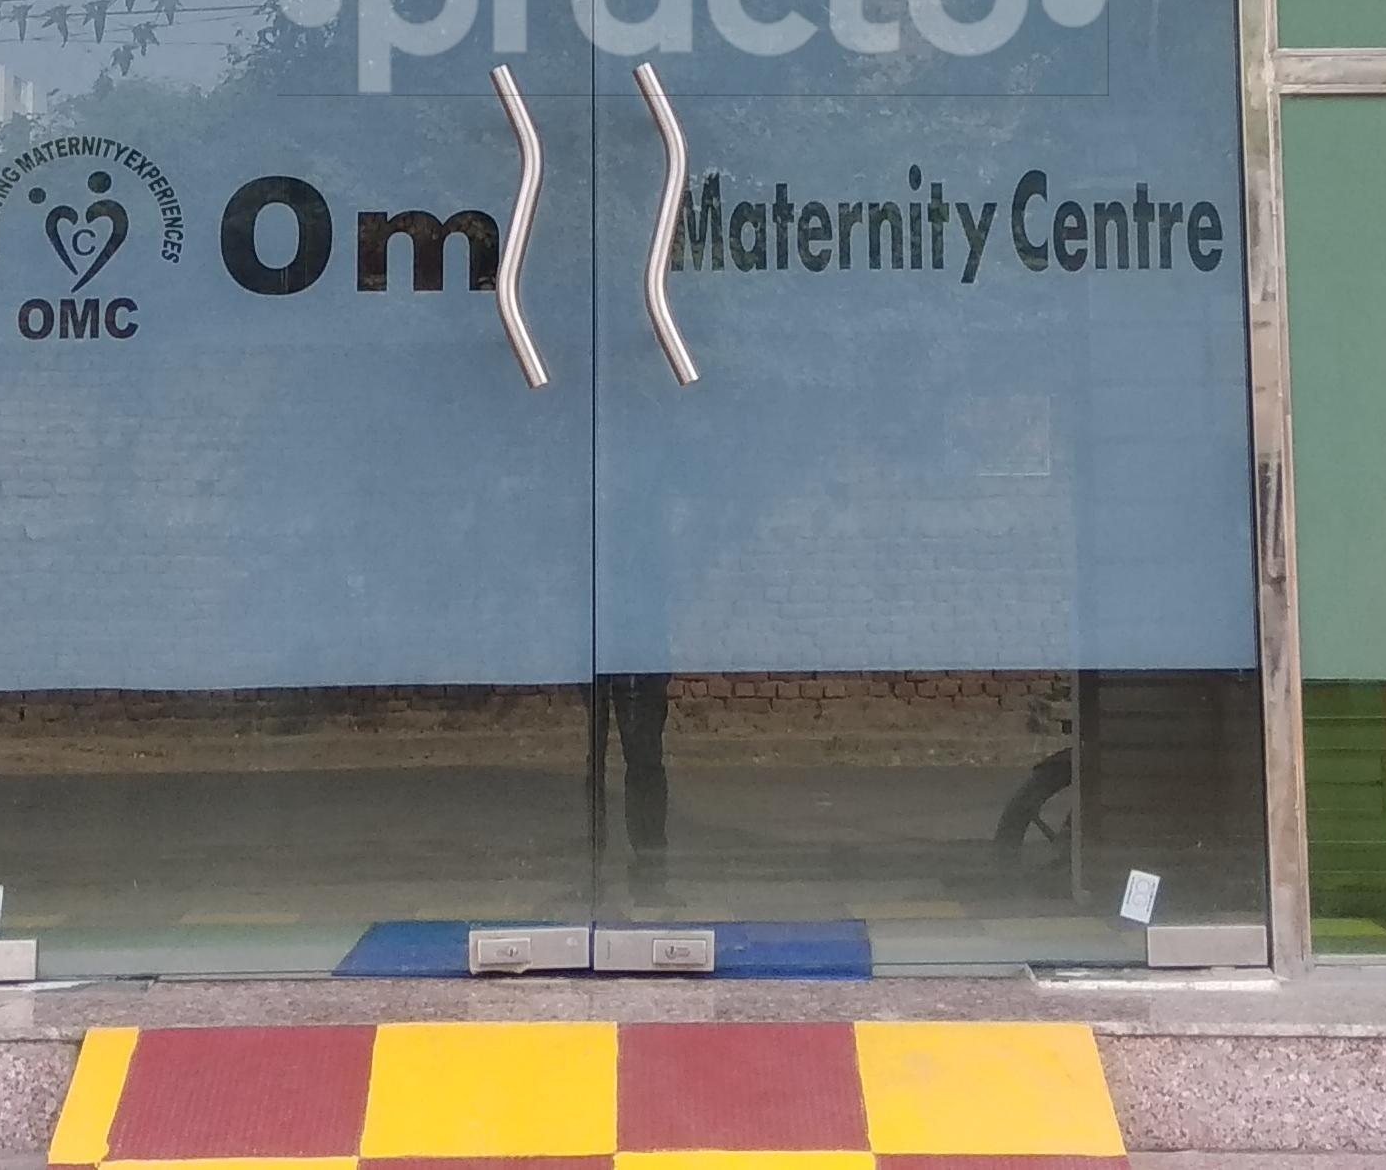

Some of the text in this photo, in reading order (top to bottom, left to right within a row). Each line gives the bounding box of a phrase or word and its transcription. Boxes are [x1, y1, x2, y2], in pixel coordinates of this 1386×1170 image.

[71, 228, 97, 256] C
[220, 164, 1224, 296] Om Maternity Centre
[17, 297, 139, 341] OMC
